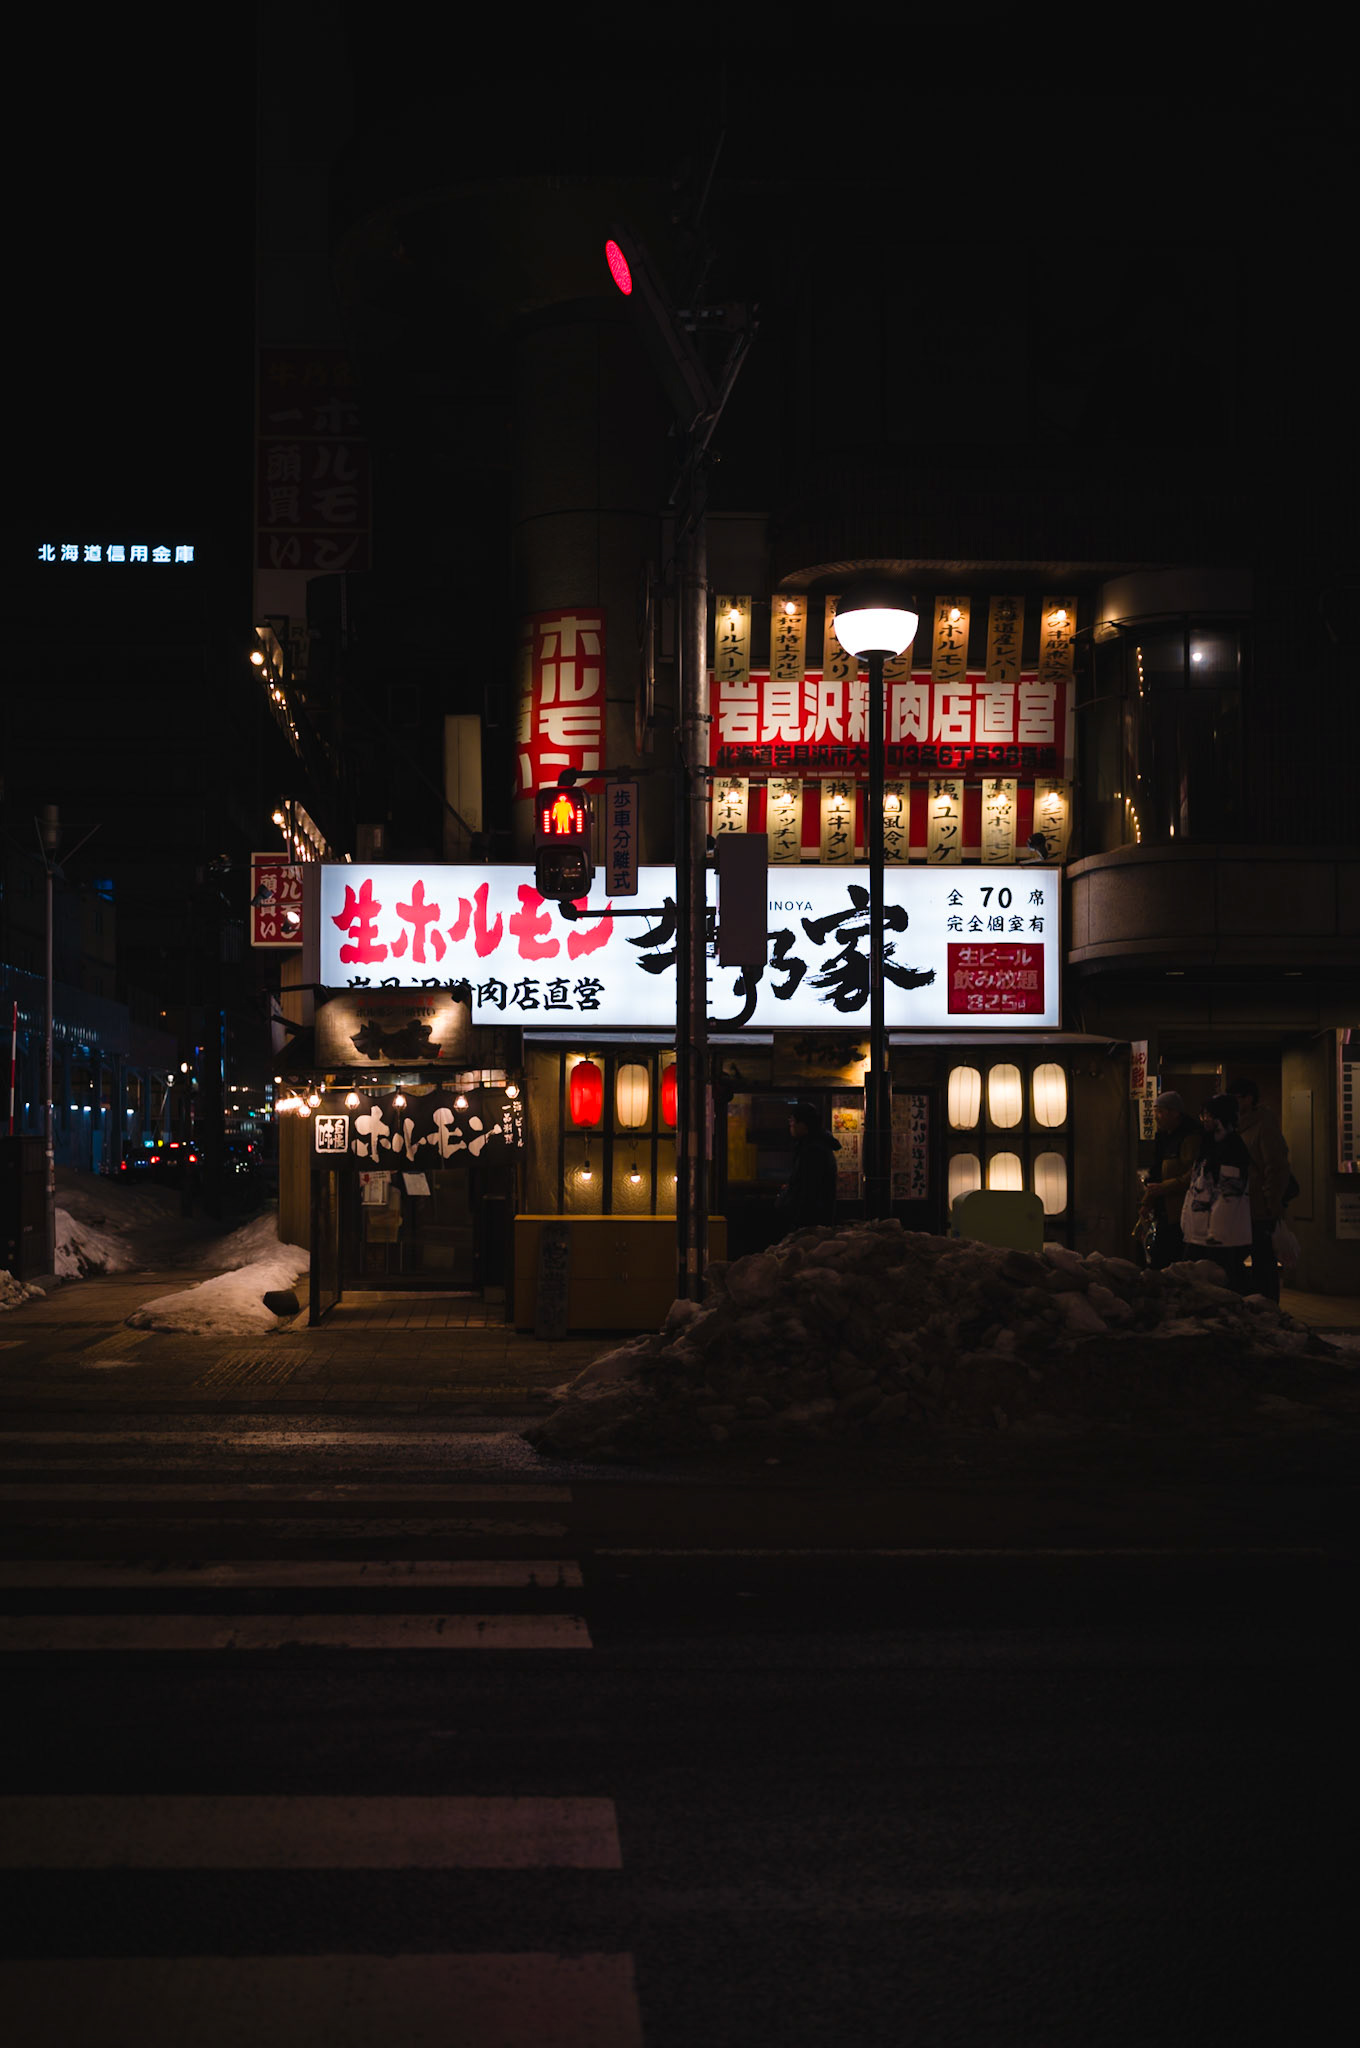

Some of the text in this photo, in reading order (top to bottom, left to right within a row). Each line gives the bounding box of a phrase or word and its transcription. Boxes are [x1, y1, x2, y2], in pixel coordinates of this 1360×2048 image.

[266, 407, 303, 570] 一頭買い
[311, 397, 360, 571] ホルモン
[37, 543, 195, 564] 北海道信用金庫
[539, 616, 601, 789] ホルモン
[612, 789, 632, 890] 歩車分離式
[769, 900, 813, 912] INOYA
[947, 887, 1044, 908] 全 70 席
[331, 878, 613, 964] 生ホルモン
[947, 915, 1045, 933] 完全個室有
[958, 947, 1032, 967] 生ビール
[347, 975, 605, 1011] 肉店直営
[953, 969, 1038, 990] 飲み放題
[351, 1105, 503, 1164] ホルモン
